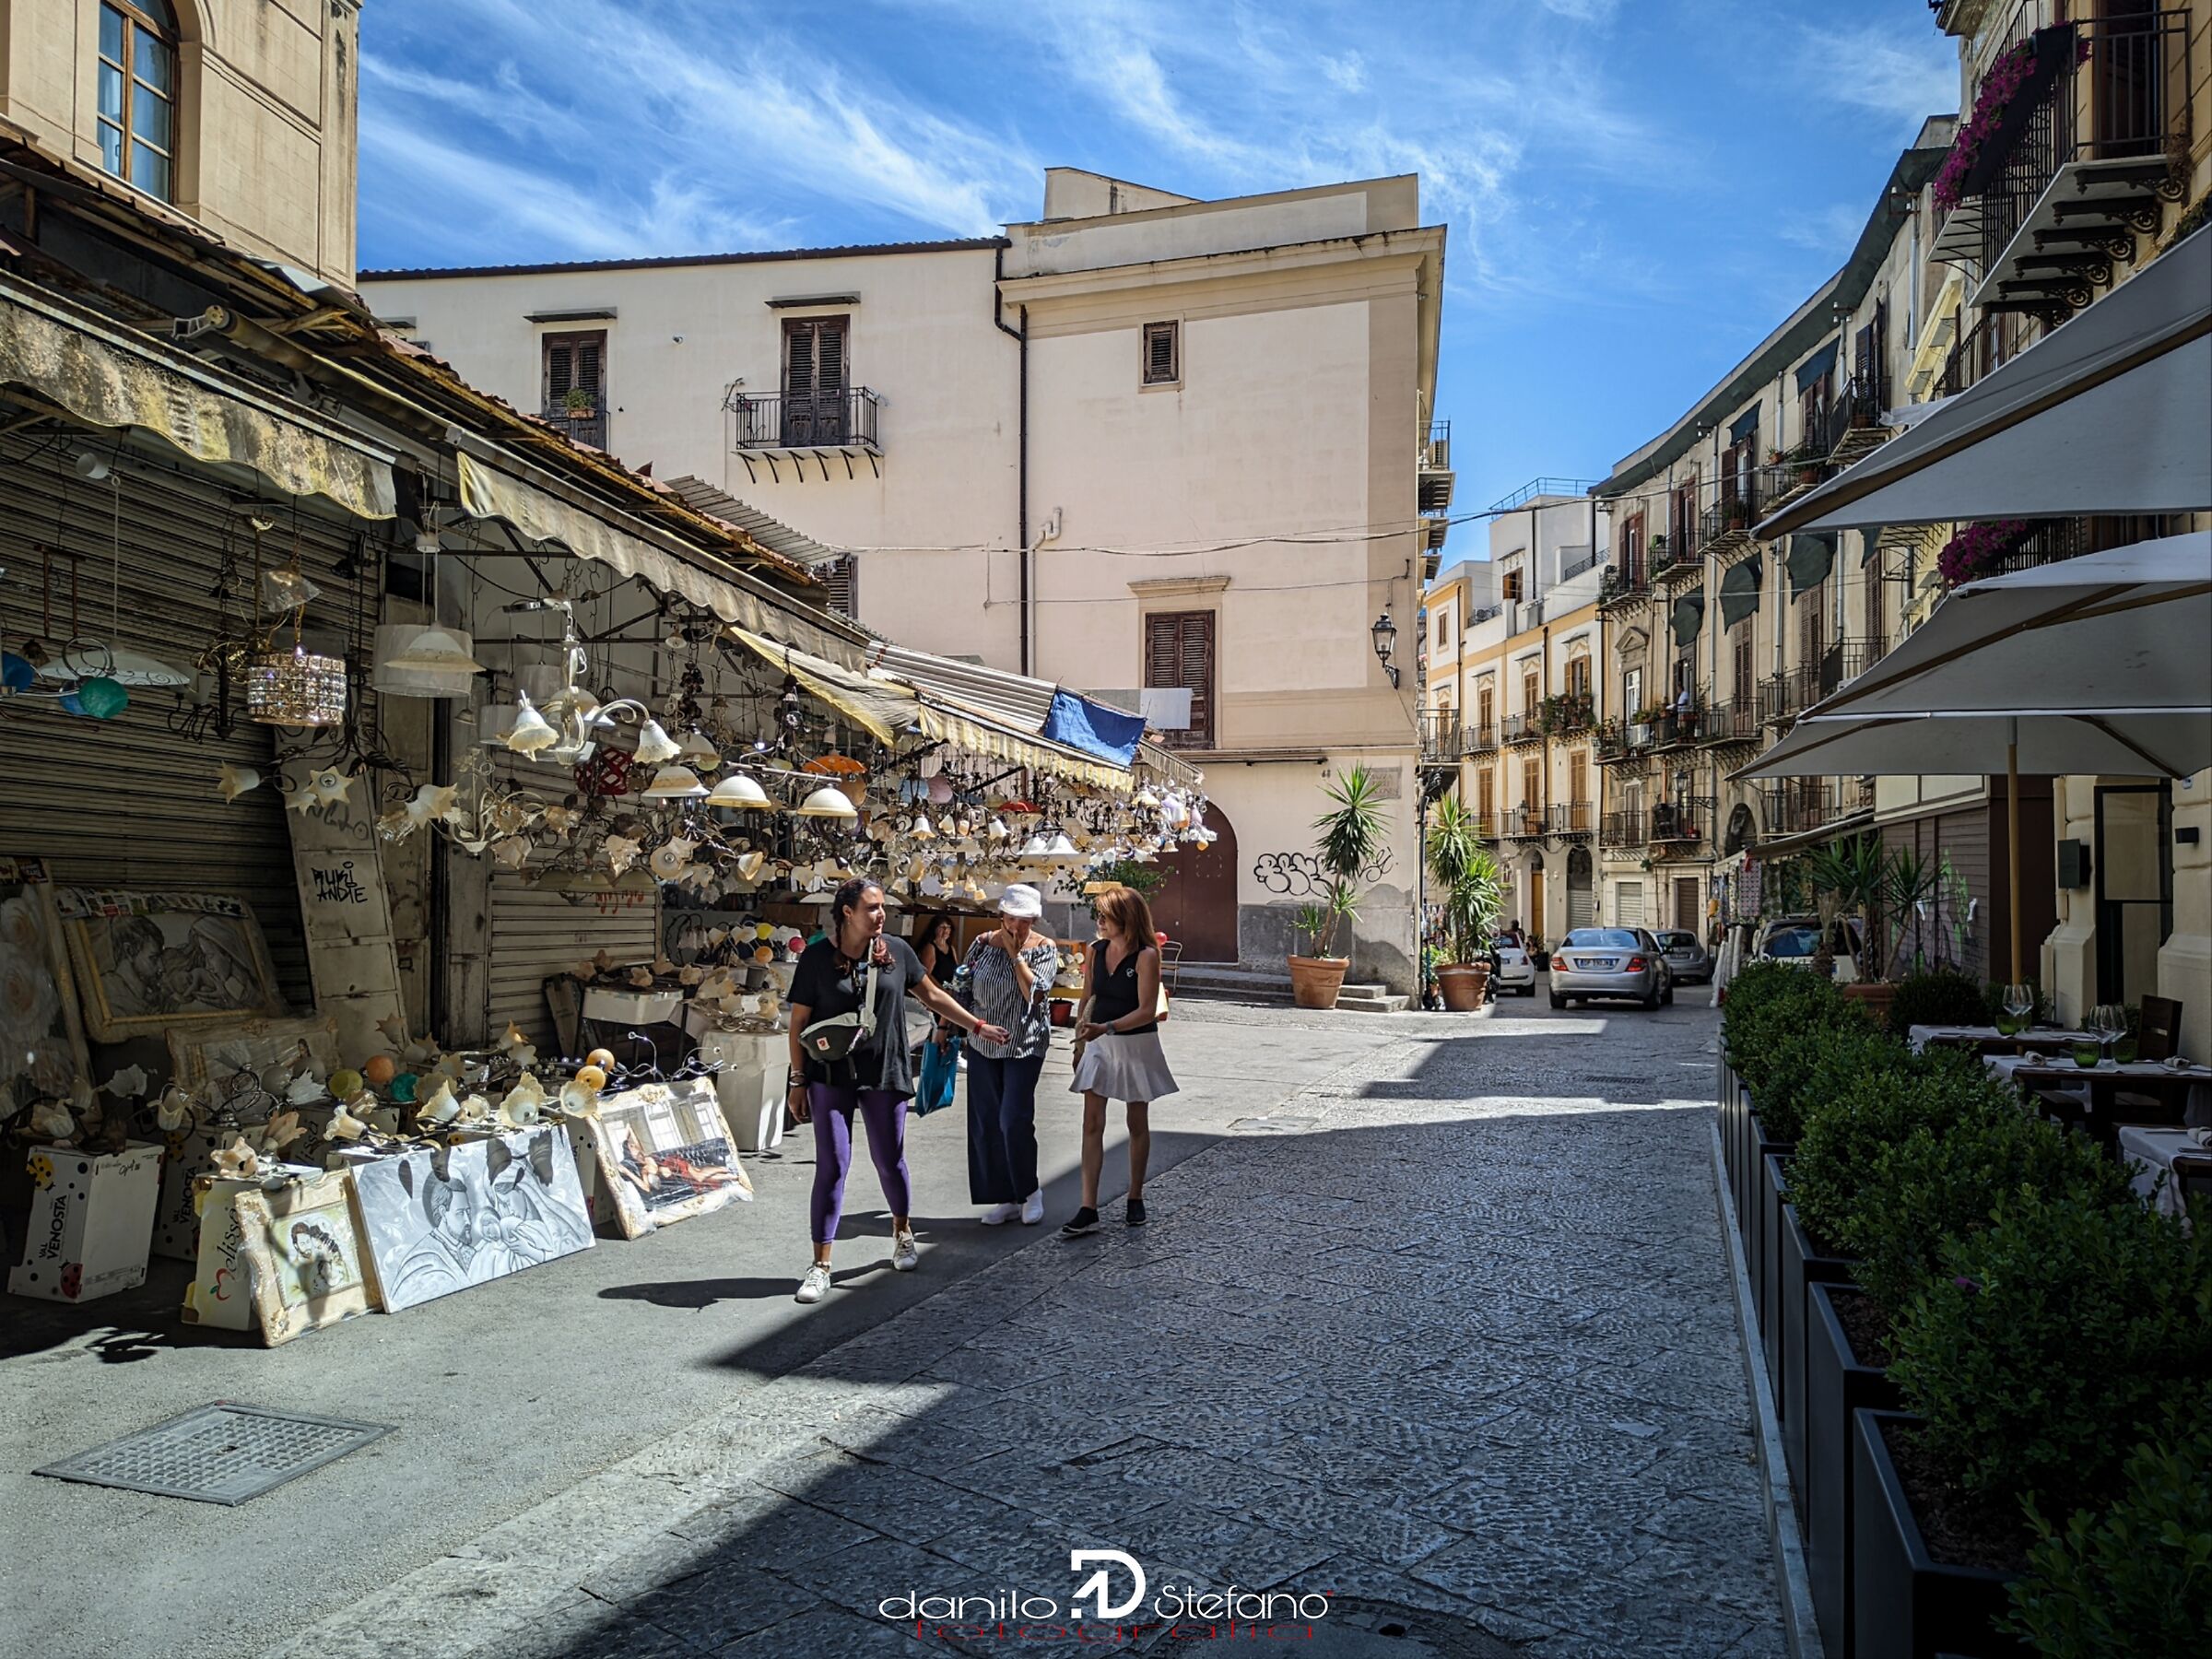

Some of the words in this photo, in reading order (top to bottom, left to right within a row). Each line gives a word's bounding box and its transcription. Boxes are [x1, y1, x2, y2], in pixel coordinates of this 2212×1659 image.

[294, 1121, 319, 1164] lissa
[179, 1166, 196, 1224] VENOSTA
[39, 1242, 48, 1259] VAL
[47, 1194, 67, 1260] VENOSTA
